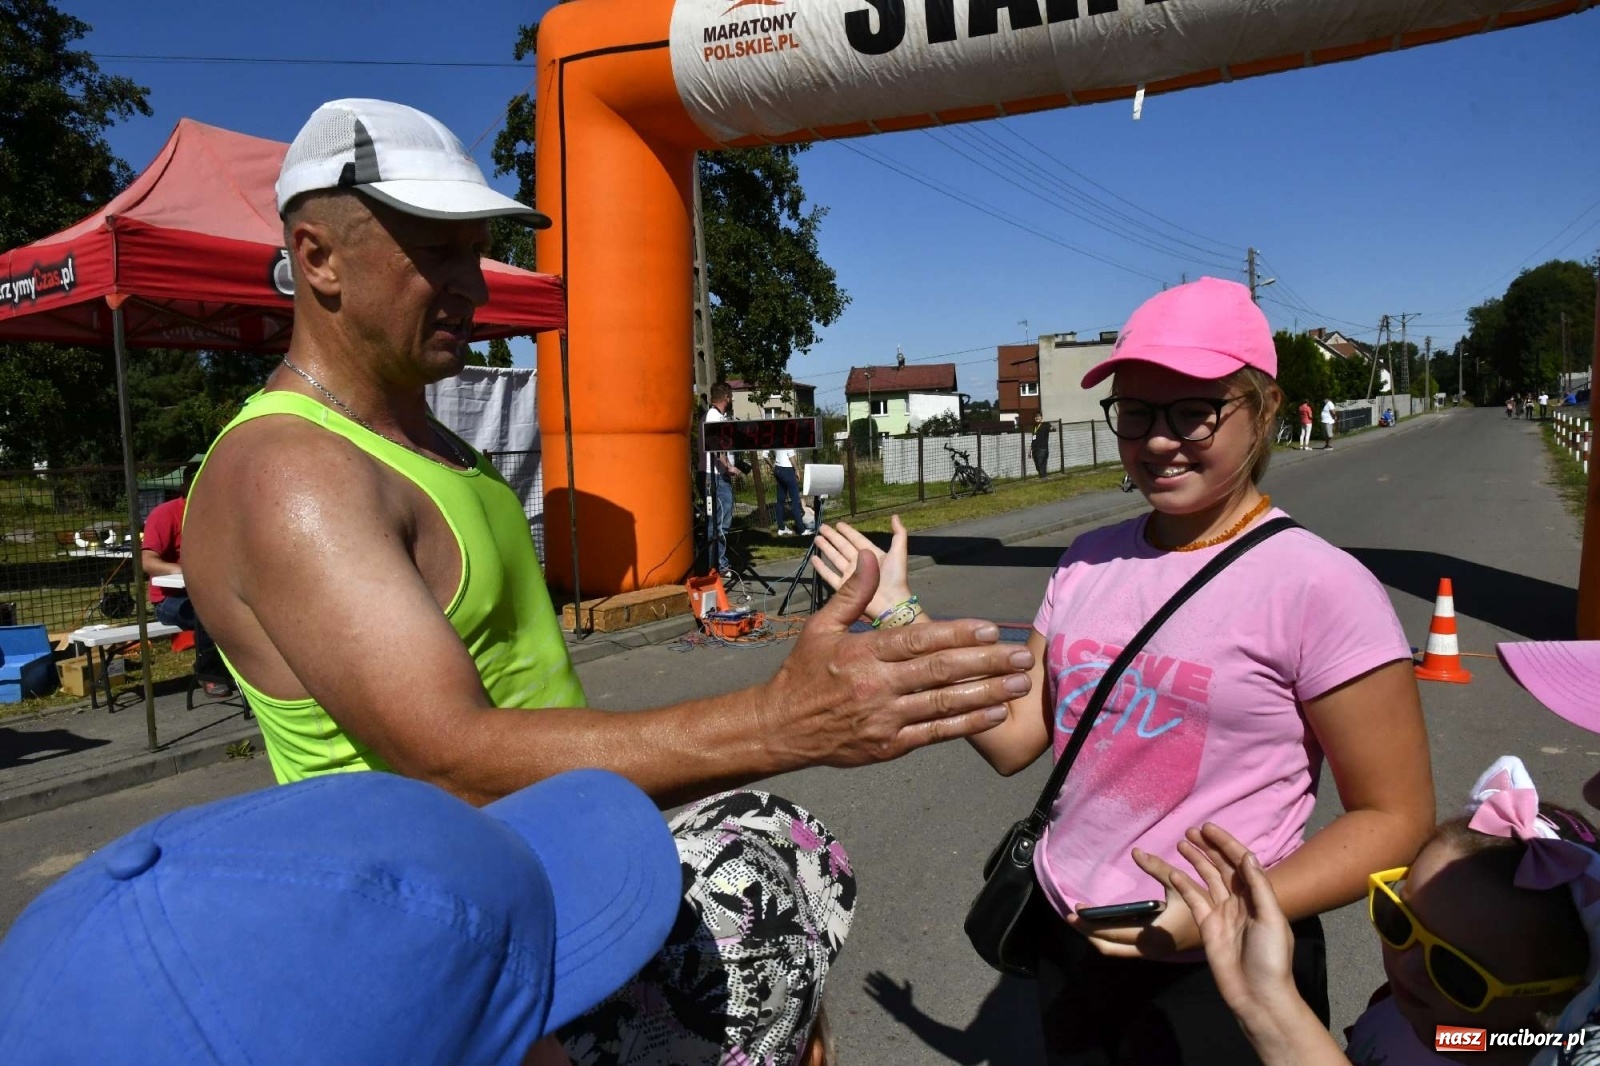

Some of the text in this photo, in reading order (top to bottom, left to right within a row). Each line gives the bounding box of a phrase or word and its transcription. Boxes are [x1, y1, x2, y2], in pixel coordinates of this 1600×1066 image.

[703, 12, 797, 43] MARATONY
[703, 33, 799, 62] POLSKIE.PL
[0, 257, 75, 303] rzymyCzas.pl
